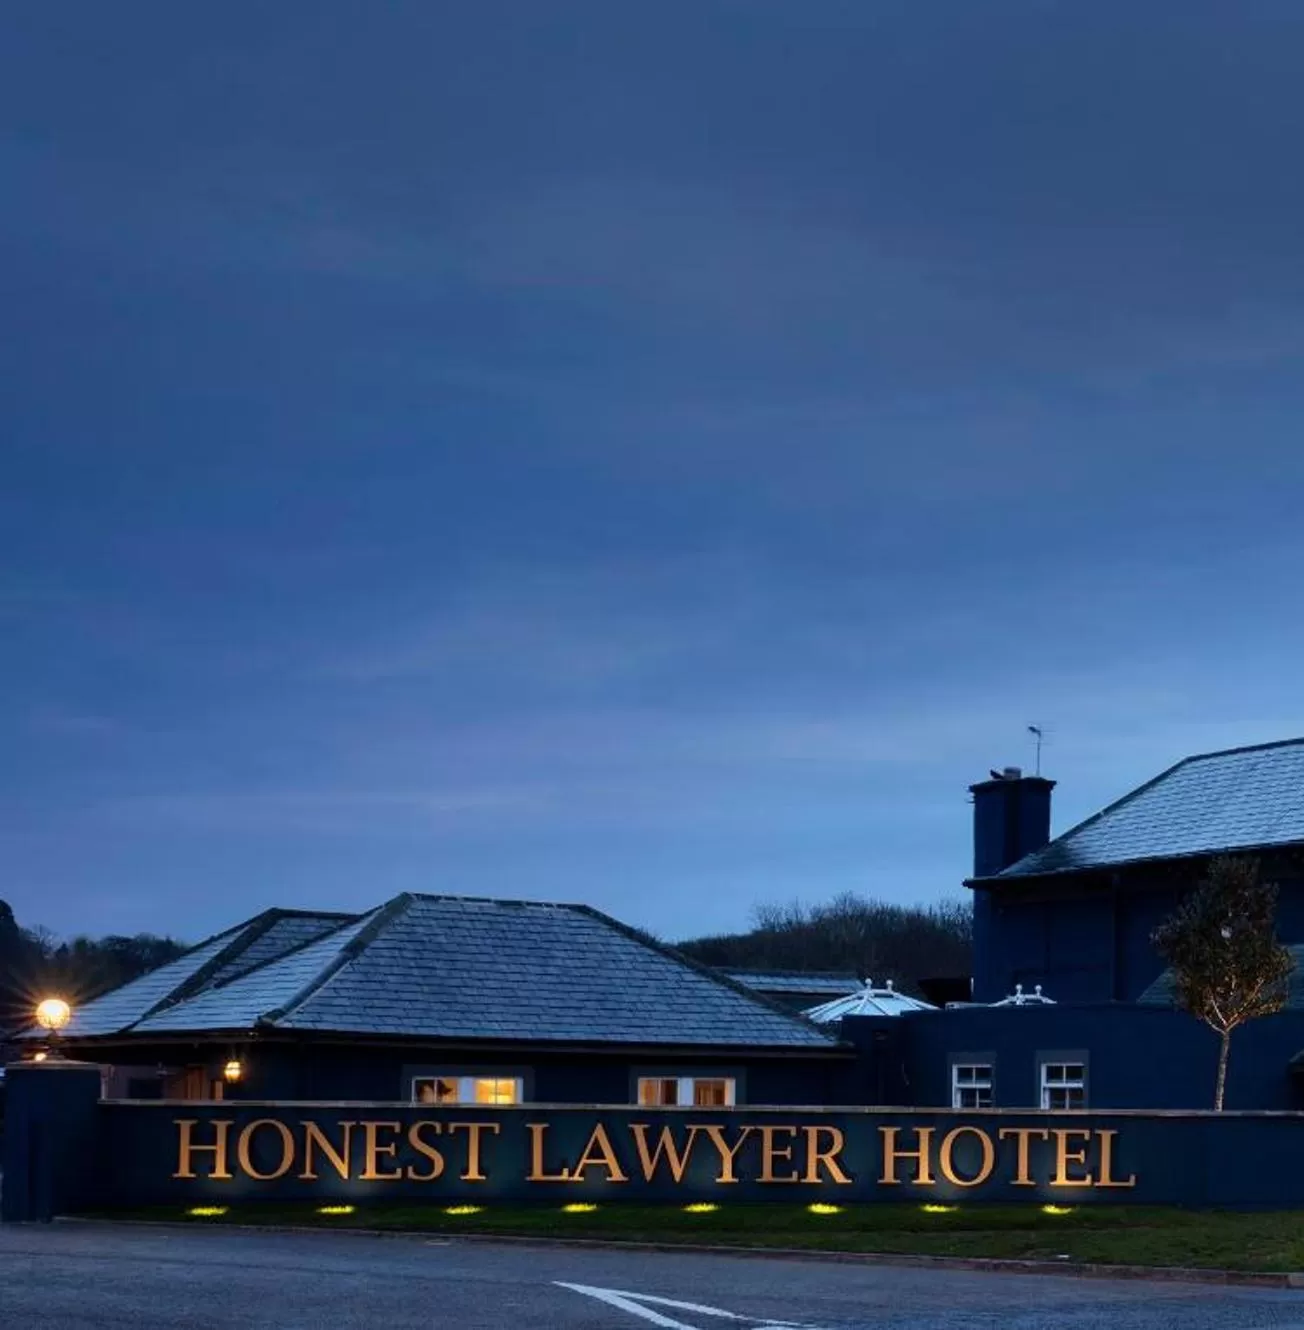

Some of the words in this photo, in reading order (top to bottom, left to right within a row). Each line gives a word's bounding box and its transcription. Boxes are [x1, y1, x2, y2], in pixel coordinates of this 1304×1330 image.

[172, 1118, 500, 1182] HONEST
[524, 1122, 853, 1184] LAWYER
[876, 1125, 1136, 1189] HOTEL
